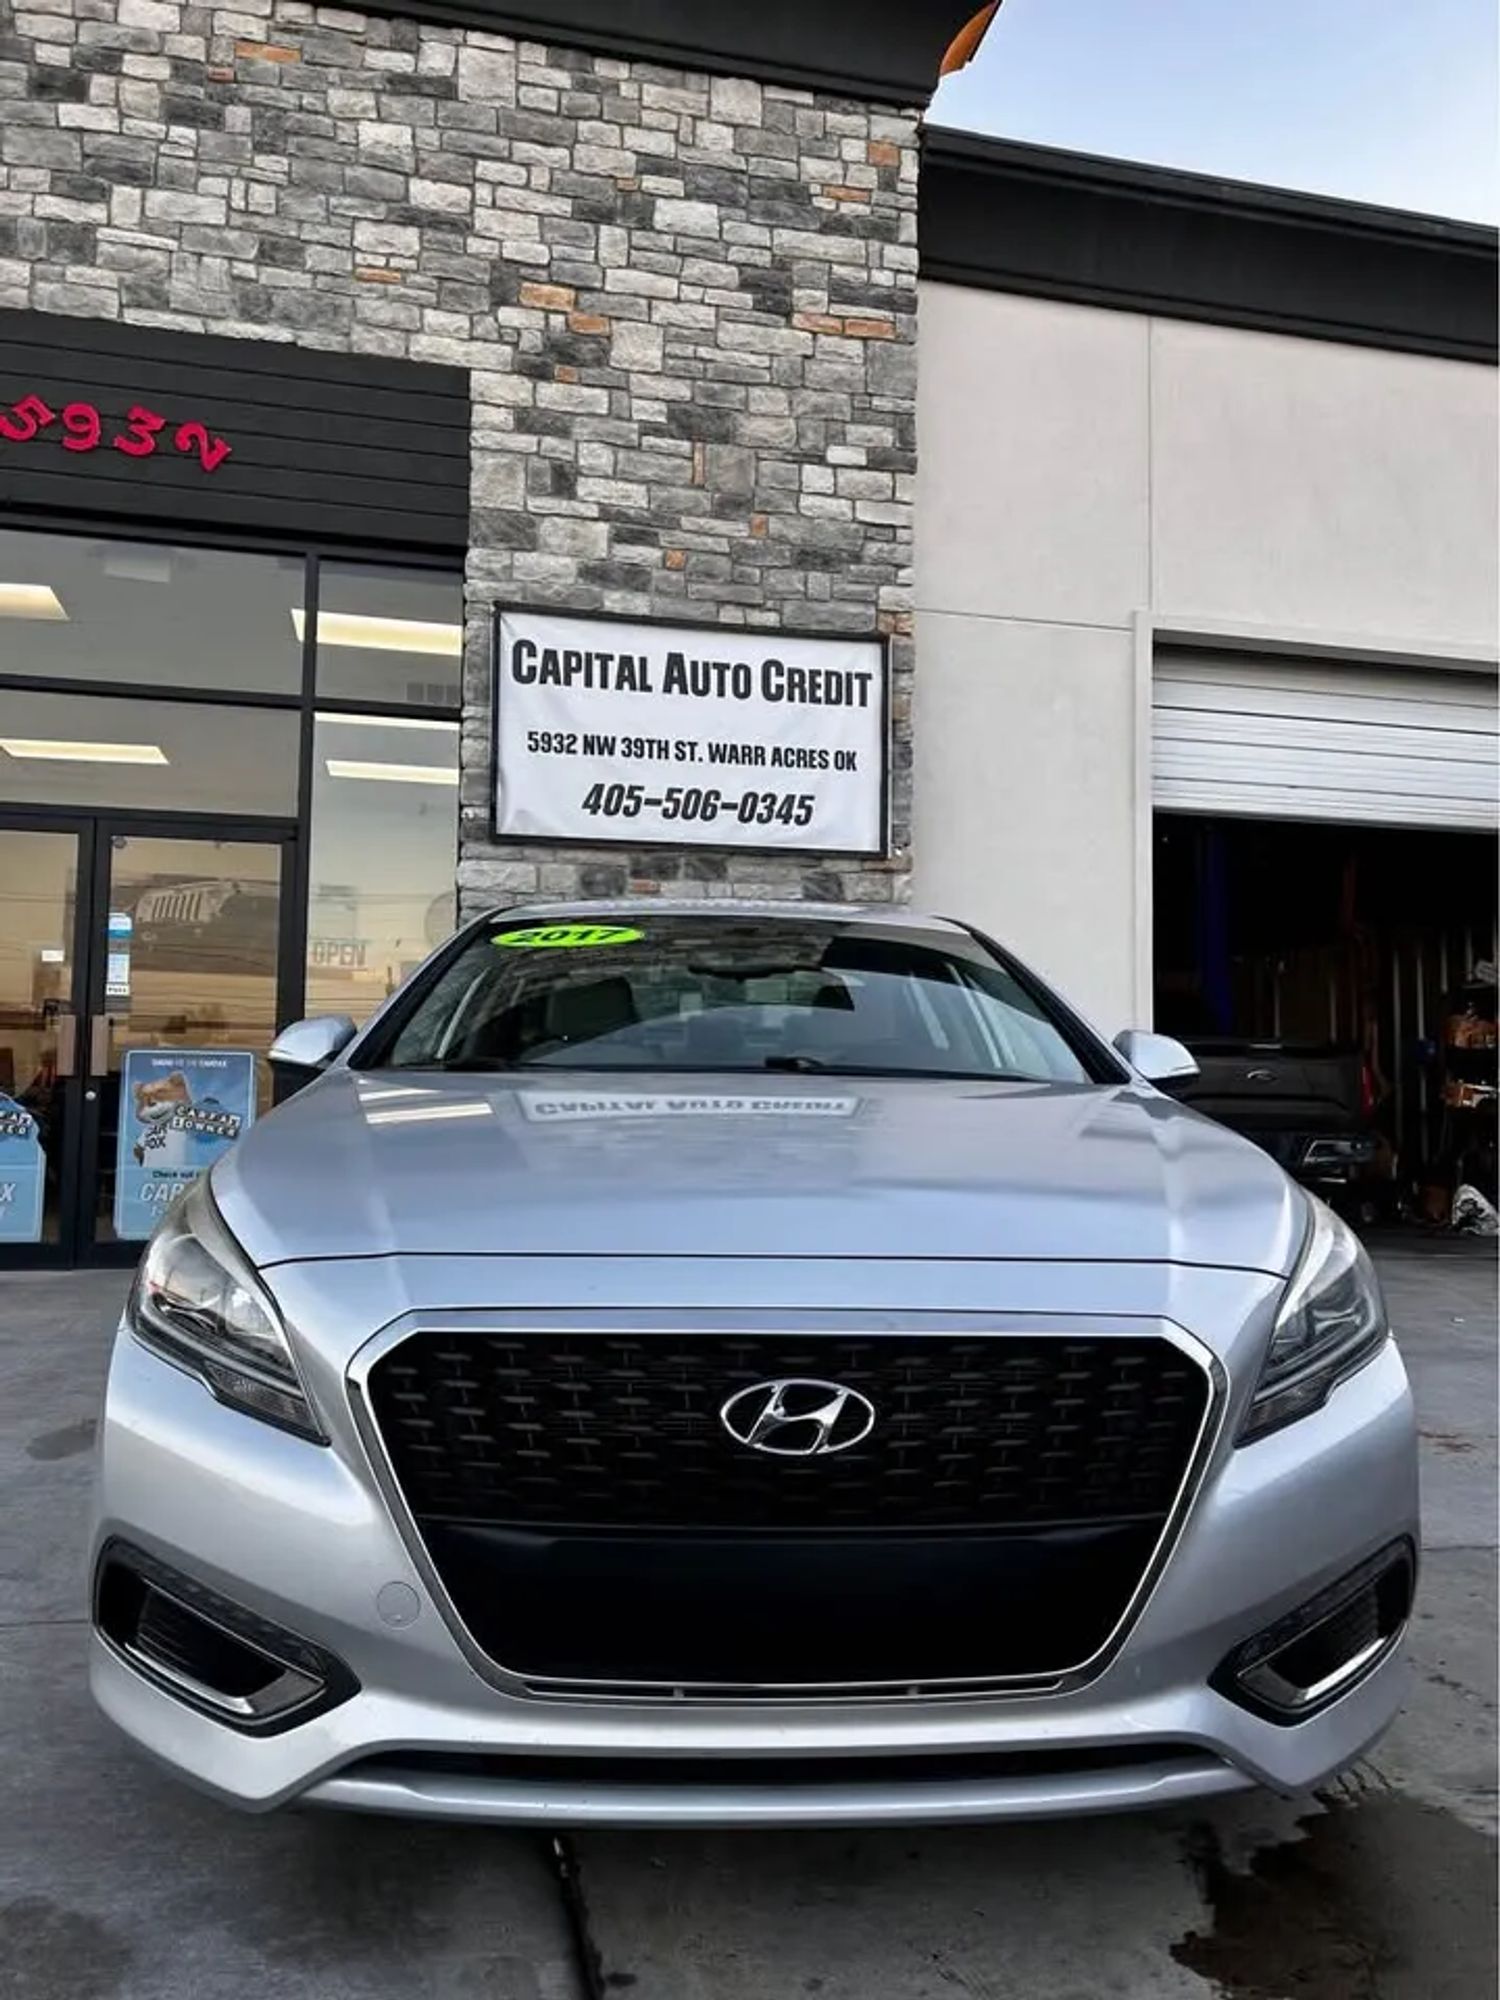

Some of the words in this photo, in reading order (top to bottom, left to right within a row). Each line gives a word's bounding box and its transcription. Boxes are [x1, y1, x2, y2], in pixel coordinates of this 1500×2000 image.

[0, 394, 231, 472] 5932
[512, 639, 652, 692] CAPITAL
[663, 652, 752, 700] AUTO
[761, 659, 872, 707] CREDIT
[527, 731, 578, 754] 5932
[583, 734, 616, 756] NW
[621, 737, 669, 760] 39TH
[674, 740, 703, 762] ST.
[708, 742, 766, 766] WARR
[771, 747, 829, 769] ACRES
[834, 750, 857, 771] OK
[582, 783, 815, 826] 405-506-0345
[510, 929, 628, 943] 2017
